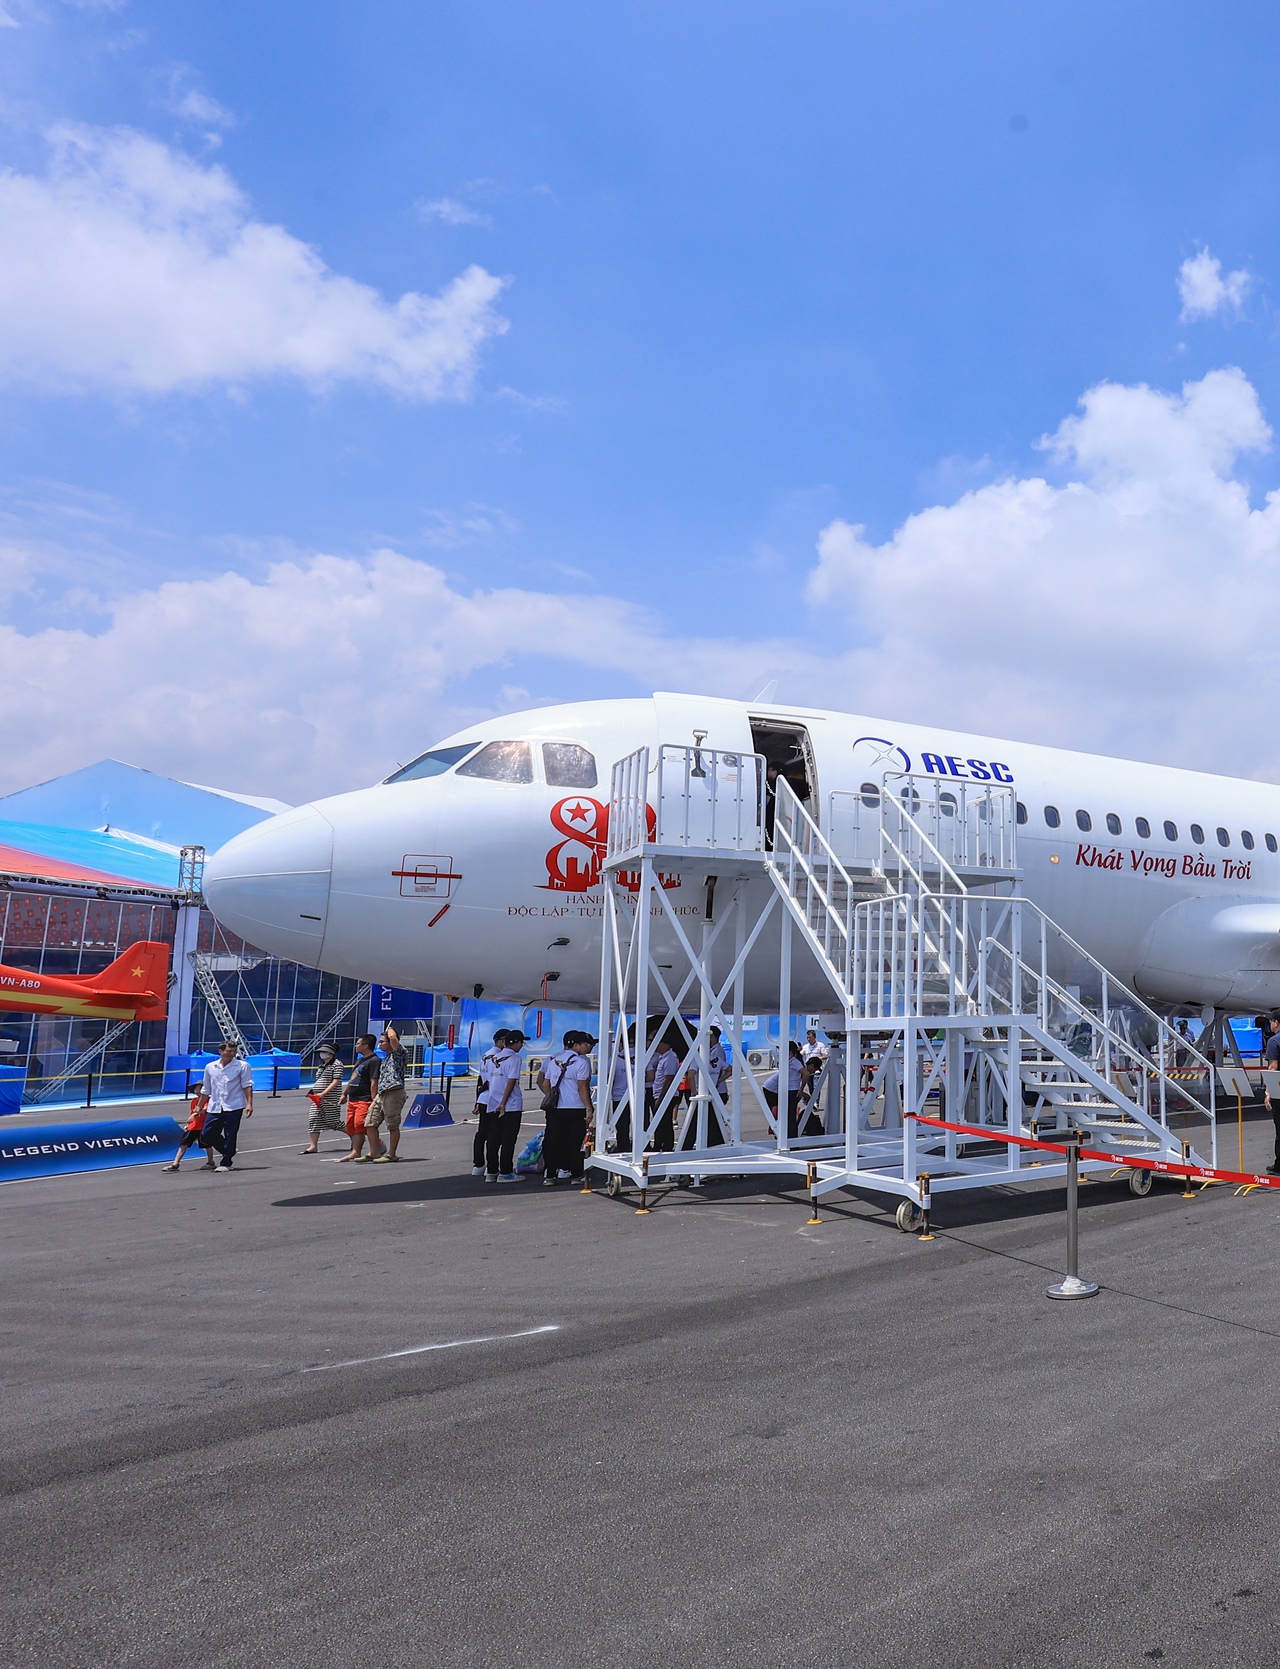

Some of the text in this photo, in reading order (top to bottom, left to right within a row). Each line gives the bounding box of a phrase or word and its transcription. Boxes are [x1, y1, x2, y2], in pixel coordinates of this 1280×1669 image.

[920, 752, 1014, 783] AESC
[1075, 844, 1252, 880] Khát Vọng Bầu Trời
[507, 906, 538, 917] ĐỘC
[541, 907, 569, 918] LẬP
[0, 976, 41, 989] VN-A80
[381, 985, 392, 1011] FLY
[2, 1134, 159, 1158] LEGEND VIETNAM
